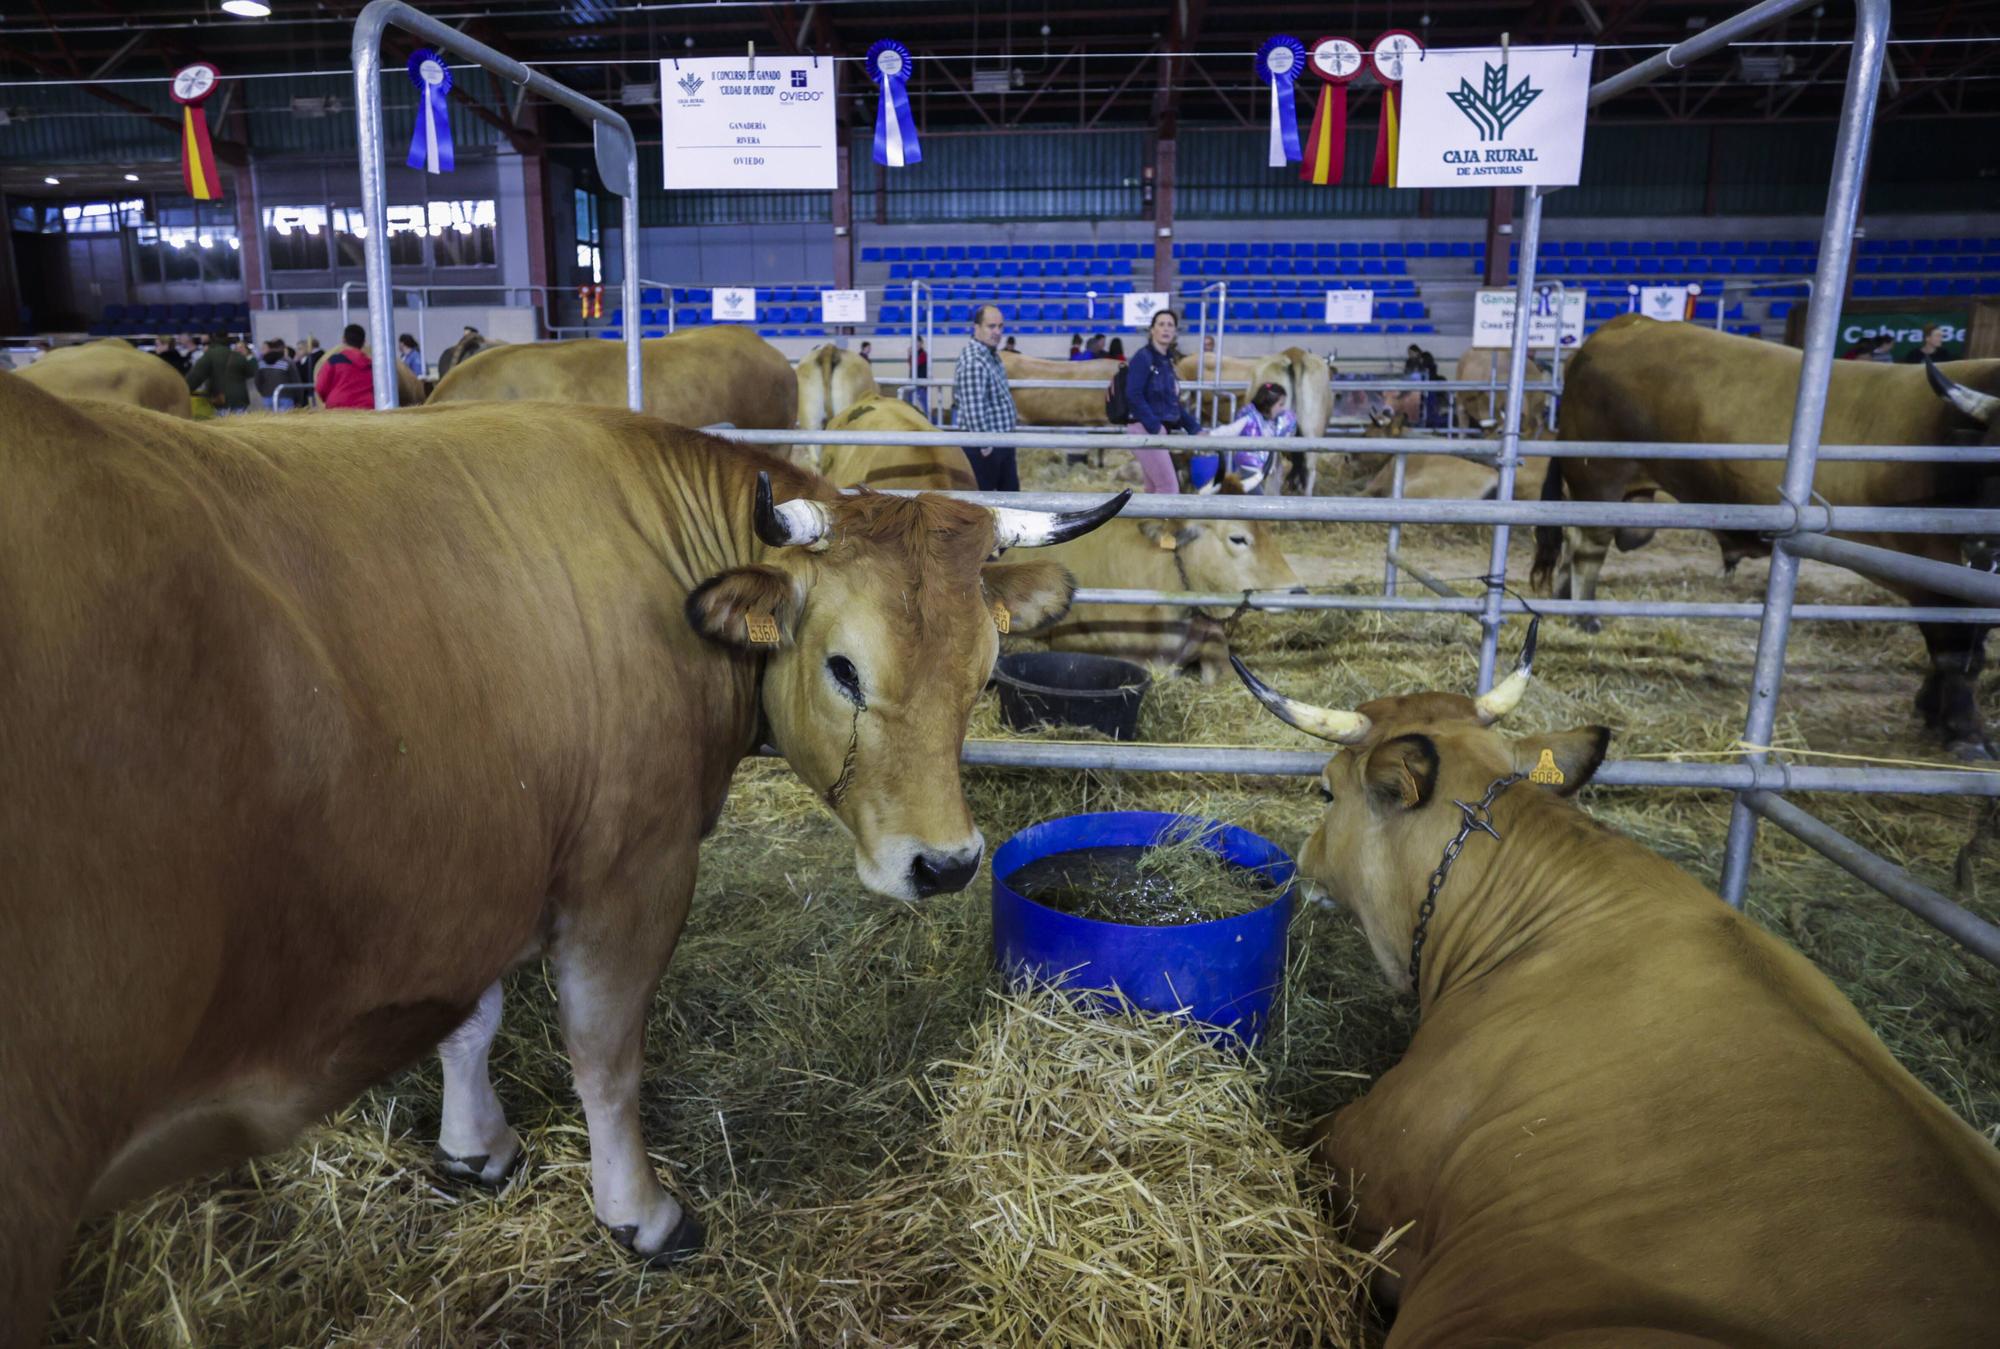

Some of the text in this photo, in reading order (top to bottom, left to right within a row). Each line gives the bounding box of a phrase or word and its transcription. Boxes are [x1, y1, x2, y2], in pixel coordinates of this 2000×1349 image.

[717, 71, 746, 80] CONCURSO
[748, 71, 755, 80] DE
[757, 71, 781, 80] GANADO
[744, 86, 751, 95] DE
[780, 91, 820, 101] OVIEDO
[729, 121, 766, 130] GANADERÍA
[1443, 148, 1538, 164] CAJA RURAL
[734, 157, 764, 165] OVIEDO
[1457, 166, 1523, 175] DE ASTURIAS
[751, 624, 778, 641] 5360
[1531, 771, 1561, 784] 5082
